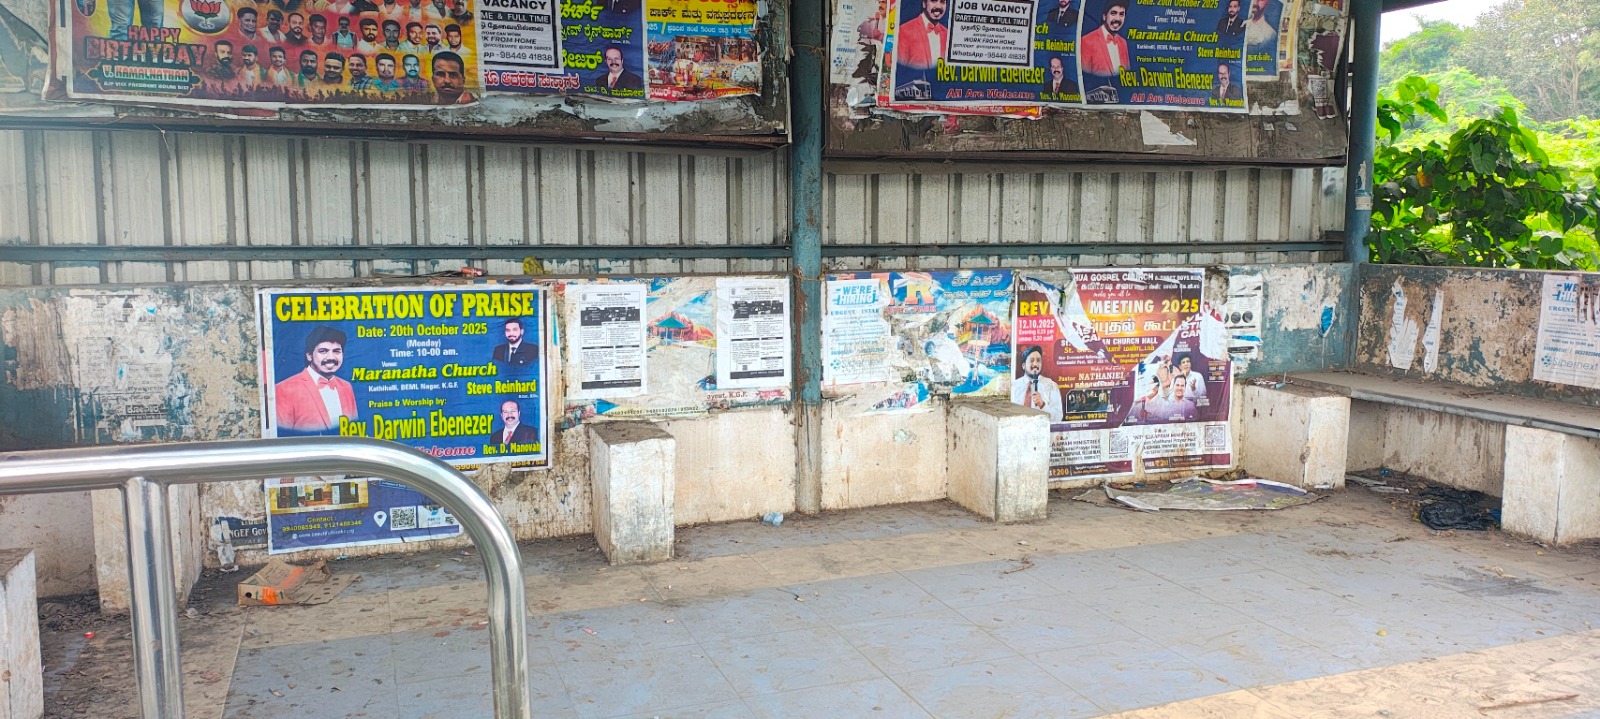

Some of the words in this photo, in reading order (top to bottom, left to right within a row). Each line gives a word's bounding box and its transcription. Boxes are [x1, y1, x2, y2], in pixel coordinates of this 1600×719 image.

[957, 2, 978, 10] JOB
[981, 3, 1028, 15] VACANCY
[1165, 9, 1188, 17] (Monday)
[507, 14, 527, 22] FULL
[529, 15, 549, 23] TIME
[1013, 18, 1028, 26] TIME
[127, 25, 181, 43] HAPPY
[490, 36, 513, 44] FROM
[1127, 28, 1181, 41] Maranatha
[1183, 31, 1219, 43] Church
[1046, 39, 1075, 52] Reinhard
[952, 50, 984, 58] WhatsApp
[1197, 46, 1214, 58] Steve
[1215, 47, 1241, 59] Reinhard
[115, 65, 189, 83] KAMALNATHAN
[936, 58, 958, 82] Rev.
[960, 64, 998, 83] Darwin
[999, 67, 1045, 84] Ebenezer
[1119, 65, 1139, 87] Rev.
[1140, 66, 1173, 88] Darwin
[1174, 67, 1214, 90] Ebenezer
[946, 88, 962, 99] All
[964, 89, 985, 99] Are
[987, 88, 1036, 100] Welcome
[1130, 93, 1146, 102] All
[1146, 93, 1163, 104] Are
[1165, 94, 1206, 106] Welcome
[1091, 272, 1120, 282] GOSPEL
[843, 285, 873, 295] WE'RE
[839, 294, 873, 305] HIRING
[275, 293, 425, 322] CELEBRATION
[429, 293, 457, 319] OF
[462, 292, 534, 317] PRAISE
[1089, 299, 1155, 315] MEETING
[1161, 299, 1199, 314] 2025
[357, 325, 387, 338] Date:
[390, 324, 414, 337] 20th
[416, 323, 459, 337] October
[462, 322, 488, 335] 2025
[1019, 319, 1055, 329] 12.10.2025
[406, 339, 442, 349] (Monday)
[1113, 337, 1140, 346] CHURCH
[1141, 337, 1158, 345] HALL
[390, 348, 414, 358] Time:
[416, 348, 441, 357] 10-00
[442, 349, 459, 357] am.
[1553, 357, 1599, 372] Sibernext
[351, 365, 438, 382] Maranatha
[441, 362, 498, 379] Church
[466, 381, 493, 396] Steve
[495, 379, 537, 394] Reinhard
[368, 400, 393, 408] Praise
[401, 398, 434, 408] Worship
[435, 397, 447, 407] by:
[338, 414, 369, 437] Rev.
[373, 410, 427, 441] Darwin
[429, 408, 494, 438] Ebenezer
[482, 444, 498, 456] Rev.
[499, 443, 509, 454] D.
[510, 441, 541, 453] Manovah
